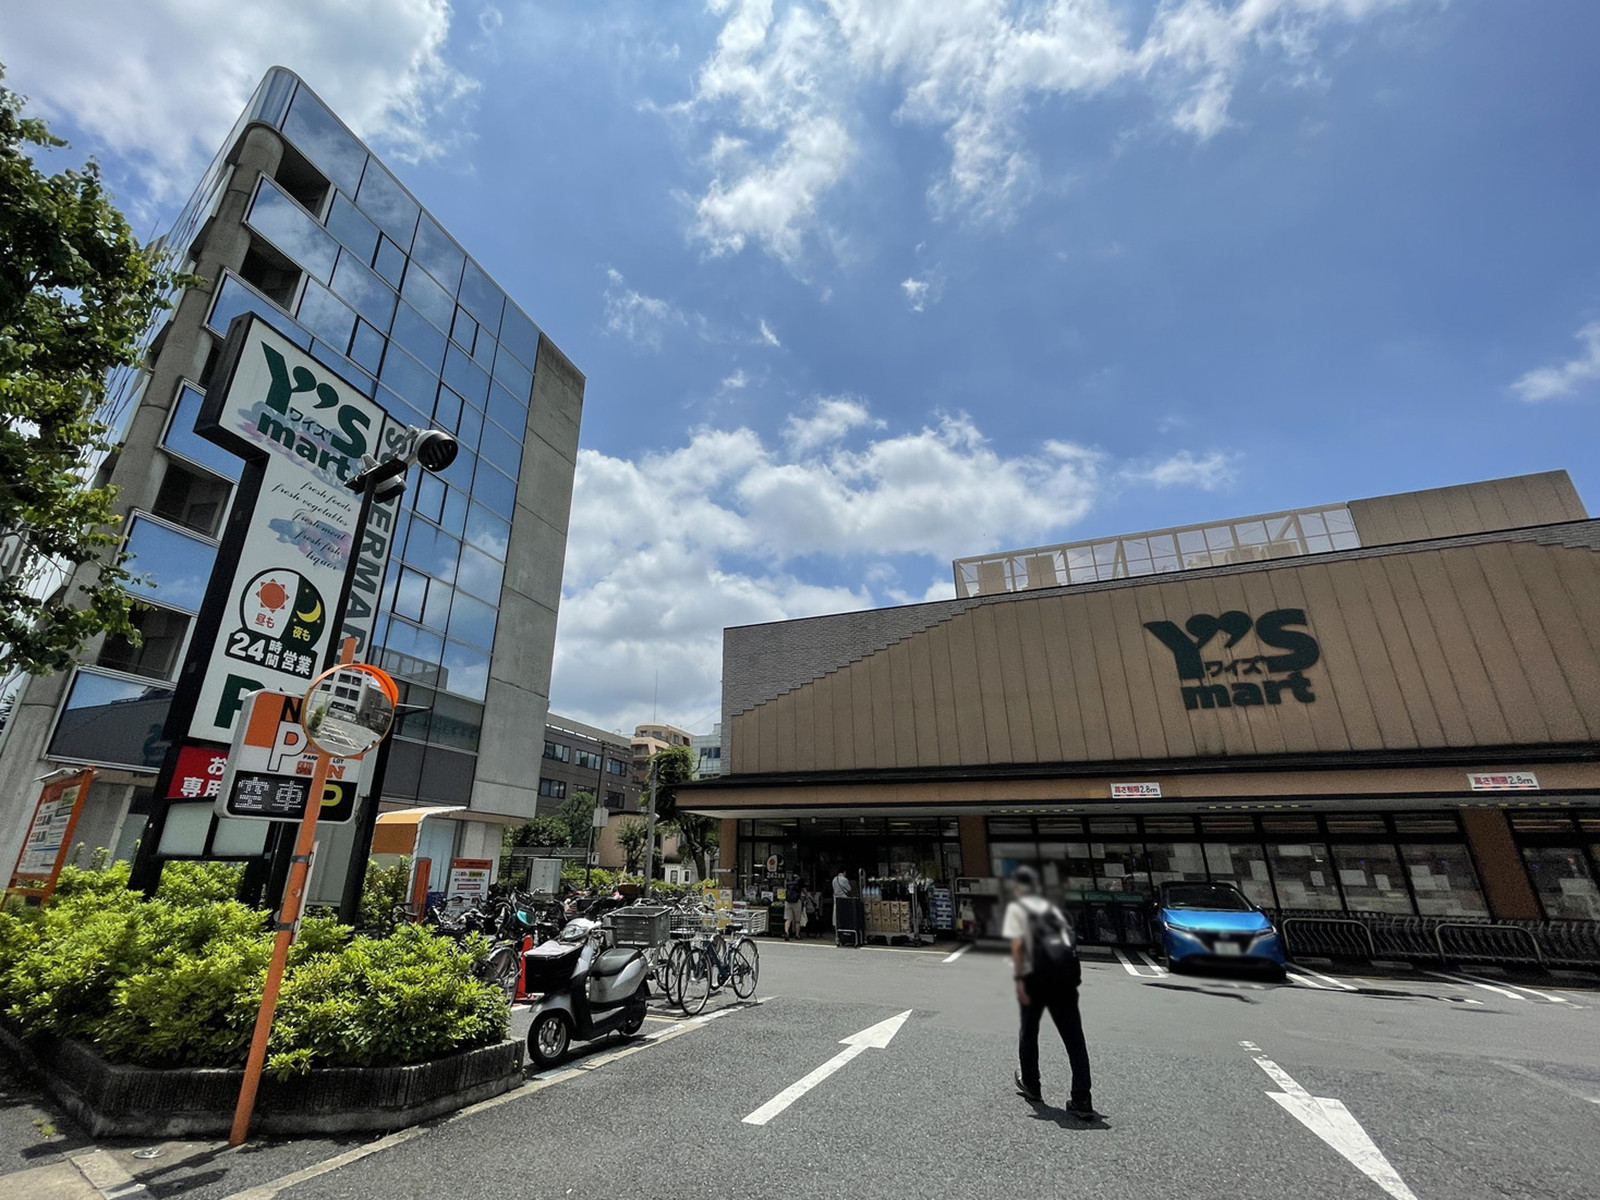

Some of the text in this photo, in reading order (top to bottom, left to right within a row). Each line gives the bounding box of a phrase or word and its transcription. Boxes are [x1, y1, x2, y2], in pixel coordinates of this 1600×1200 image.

[289, 407, 332, 441] ワイズ
[256, 412, 351, 482] mart
[271, 483, 348, 527] fresh vegetables
[300, 481, 351, 512] fresh foods
[291, 512, 346, 540] fresh meat
[294, 530, 341, 555] fresh fish
[306, 550, 337, 570] liquor
[255, 612, 275, 629] 昼も
[292, 625, 311, 642] 夜も
[229, 632, 312, 676] 24時間営業
[1205, 655, 1263, 677] ワイズ
[1180, 671, 1316, 710] mart
[267, 721, 308, 772] P
[234, 776, 304, 812] 空車
